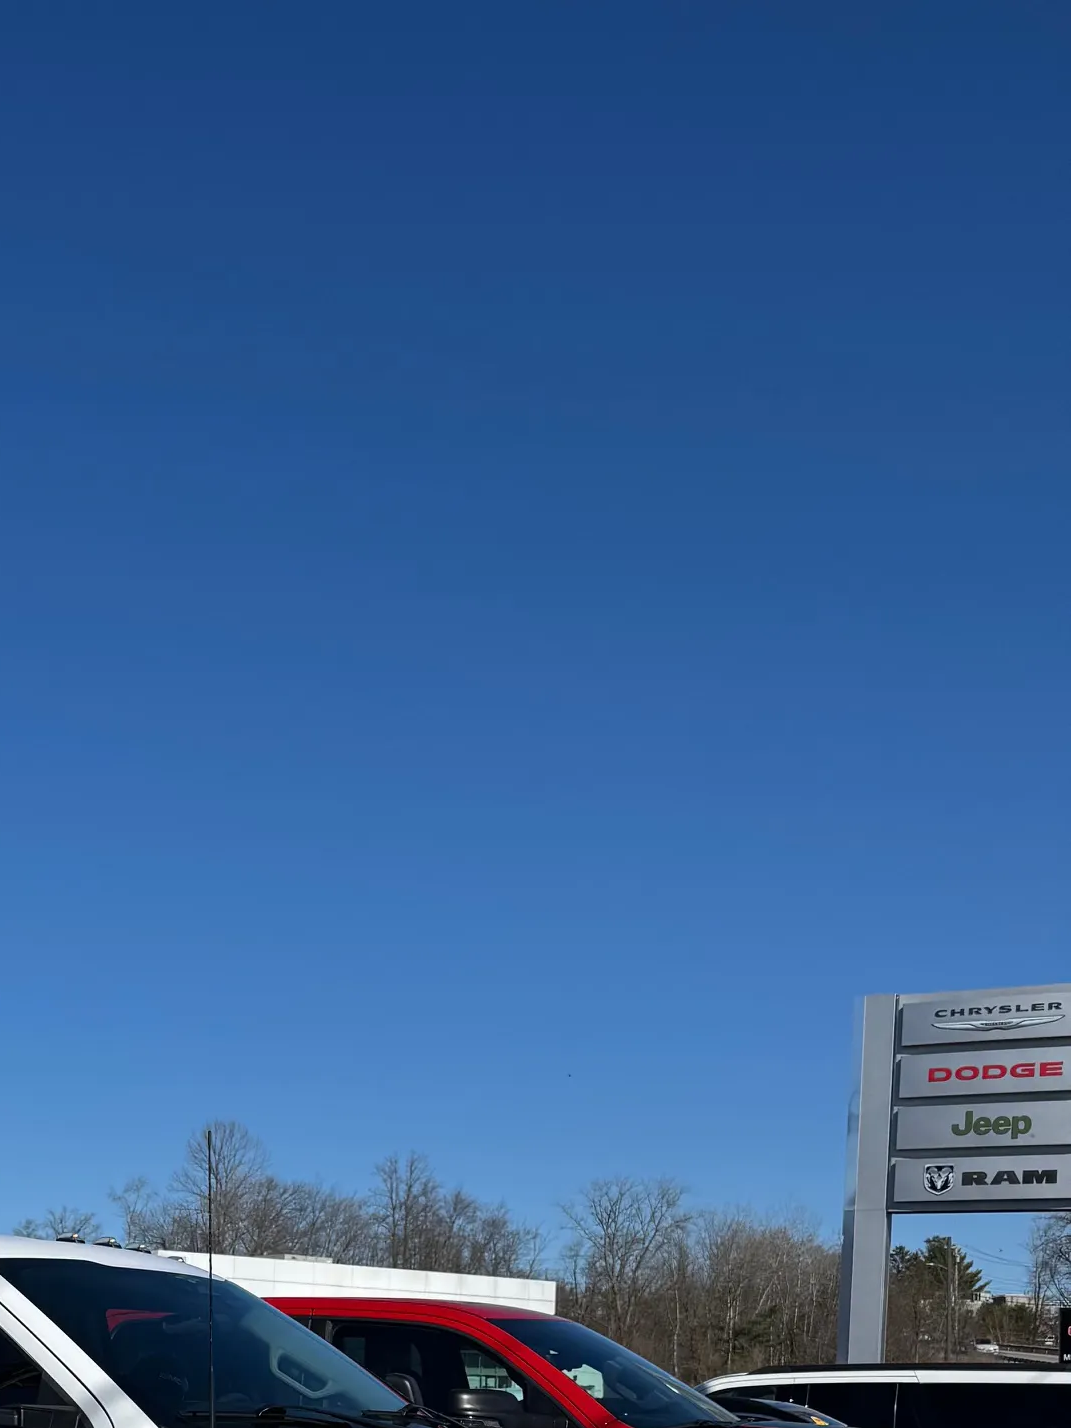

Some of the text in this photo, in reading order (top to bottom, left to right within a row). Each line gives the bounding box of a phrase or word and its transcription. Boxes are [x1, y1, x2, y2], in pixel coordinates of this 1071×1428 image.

[934, 1002, 1063, 1018] CHRYSLER
[927, 1061, 1064, 1083] DODGE
[951, 1110, 1032, 1140] Jeep
[961, 1170, 1058, 1187] RAM
